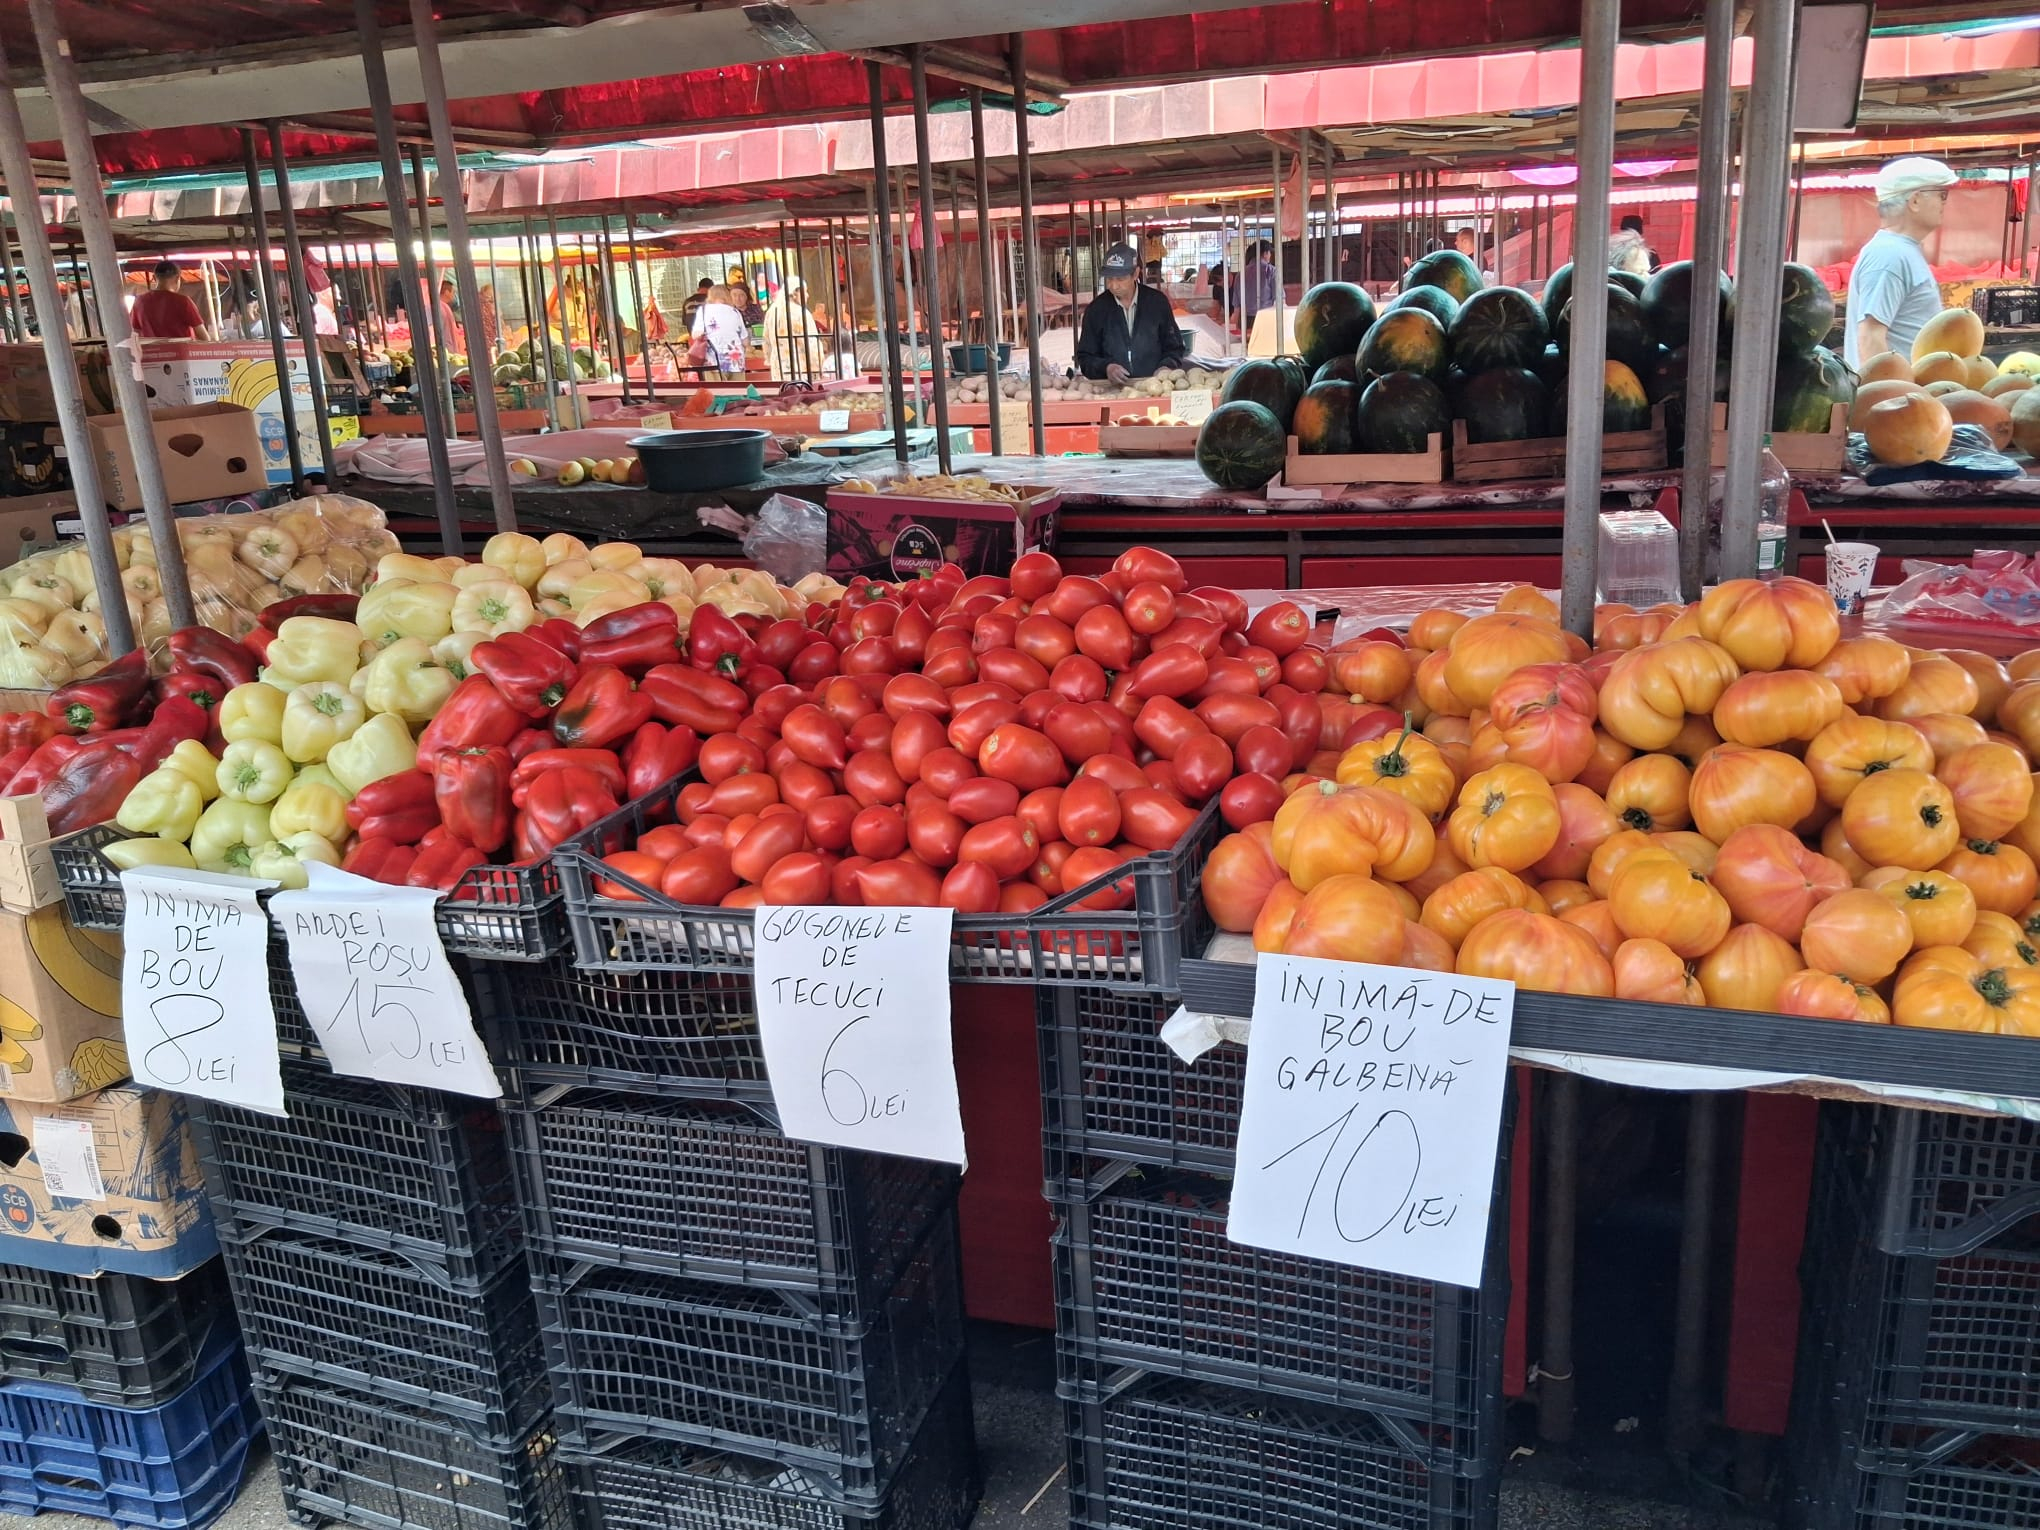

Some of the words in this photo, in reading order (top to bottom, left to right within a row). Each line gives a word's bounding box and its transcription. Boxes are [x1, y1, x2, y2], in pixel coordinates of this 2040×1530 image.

[193, 376, 229, 386] BANANAS
[195, 387, 230, 396] PREMIUM
[264, 426, 284, 436] SCB
[175, 925, 216, 952] DE
[762, 906, 912, 942] GOGONELE
[140, 950, 224, 990] BOU
[822, 945, 858, 967] DE
[327, 977, 435, 1059] 15
[1321, 1013, 1416, 1054] BOU
[144, 993, 225, 1085] 8
[822, 1015, 870, 1126] 6
[1262, 1102, 1421, 1243] 10
[3, 1193, 27, 1207] SCB
